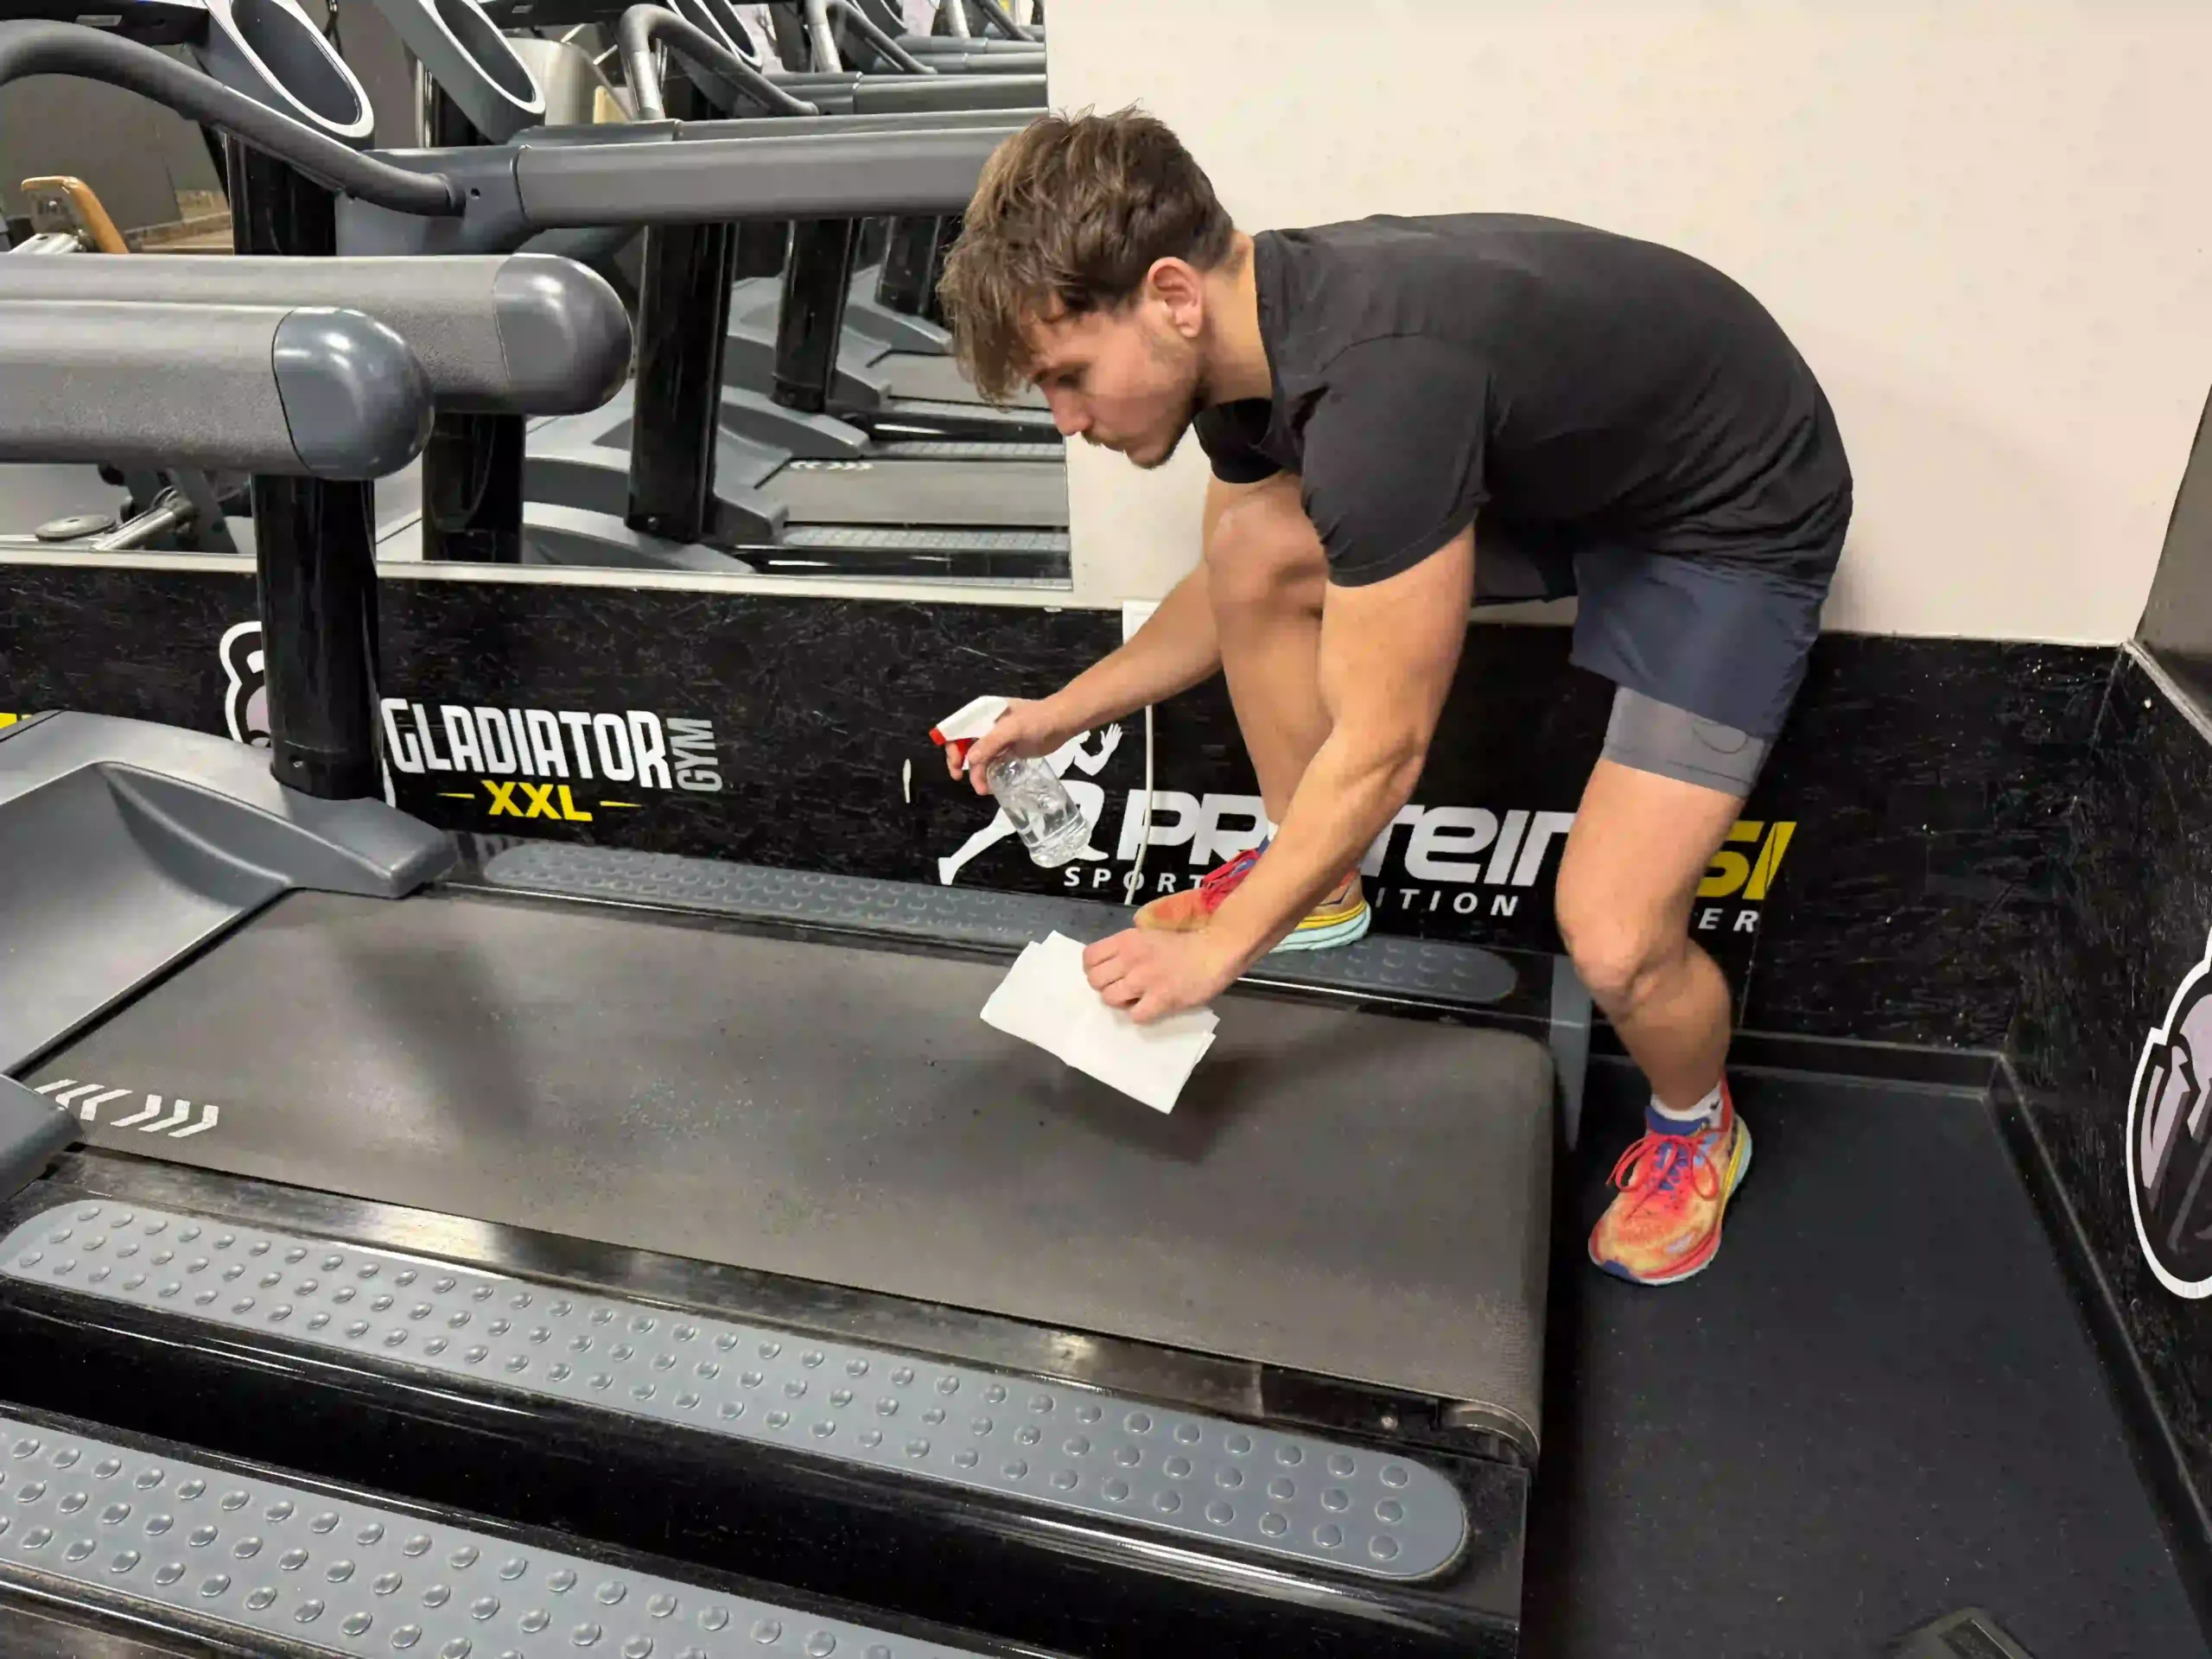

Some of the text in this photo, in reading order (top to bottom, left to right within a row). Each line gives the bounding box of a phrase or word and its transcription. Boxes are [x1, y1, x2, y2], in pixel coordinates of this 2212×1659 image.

[380, 697, 672, 789] GLADIATOR
[666, 717, 722, 791] GYM
[480, 779, 593, 822] XXL
[1374, 887, 1519, 917] ITION
